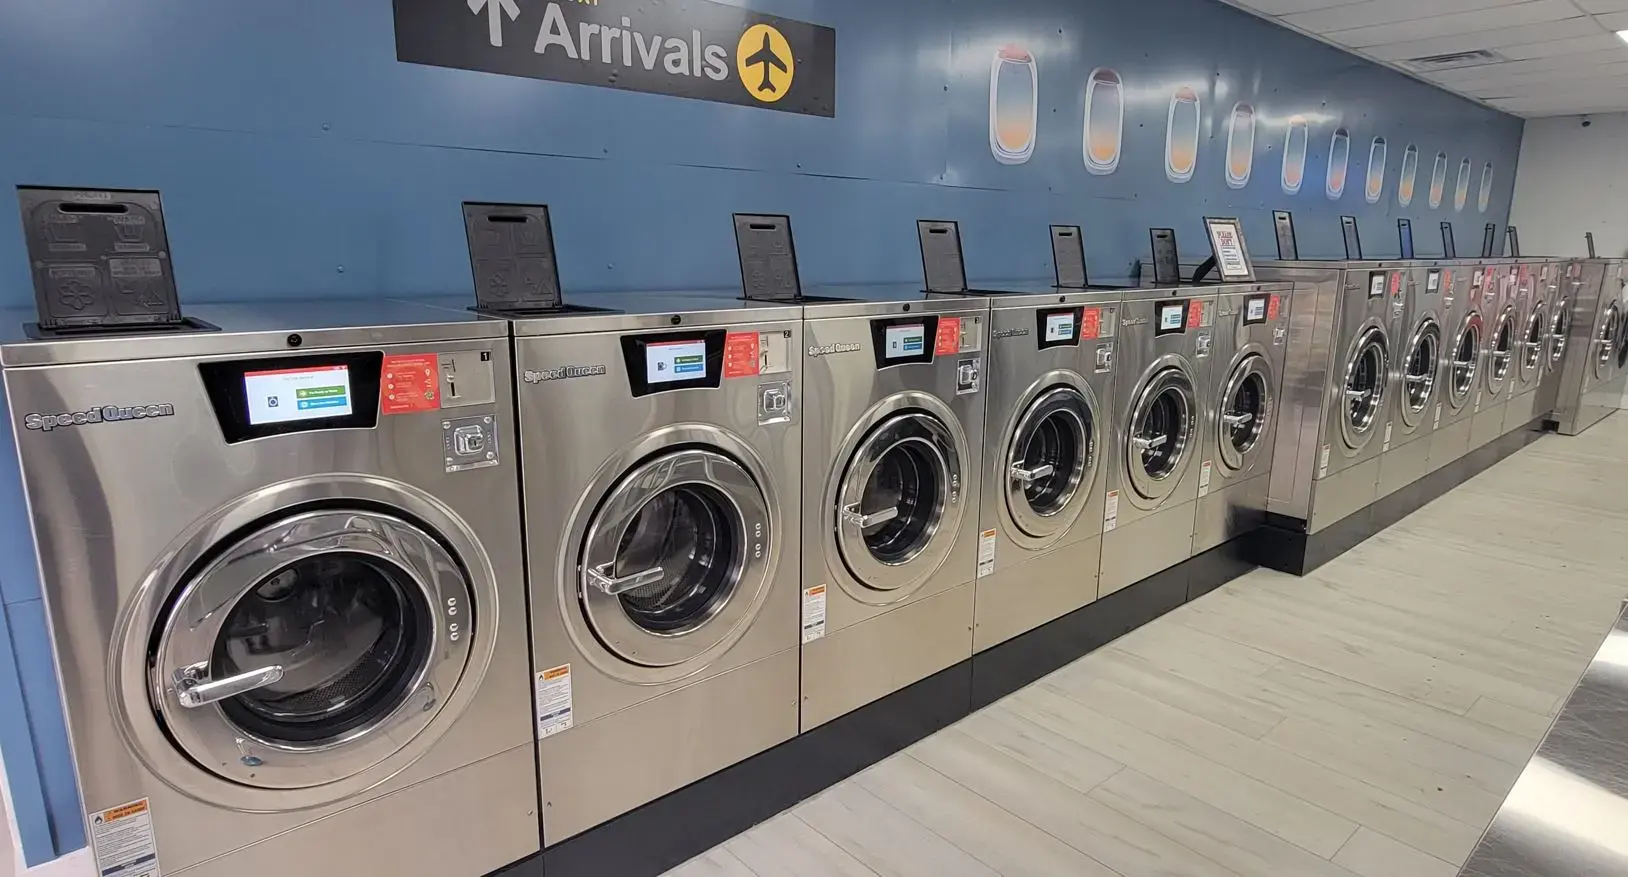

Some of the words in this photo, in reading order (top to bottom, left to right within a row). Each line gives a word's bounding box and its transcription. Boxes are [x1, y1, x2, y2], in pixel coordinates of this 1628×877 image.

[533, 2, 730, 82] Arrivals
[808, 344, 835, 358] Speed
[523, 365, 566, 384] Speed
[565, 364, 606, 378] Queen
[24, 407, 103, 432] Speed
[102, 402, 175, 422] Queen
